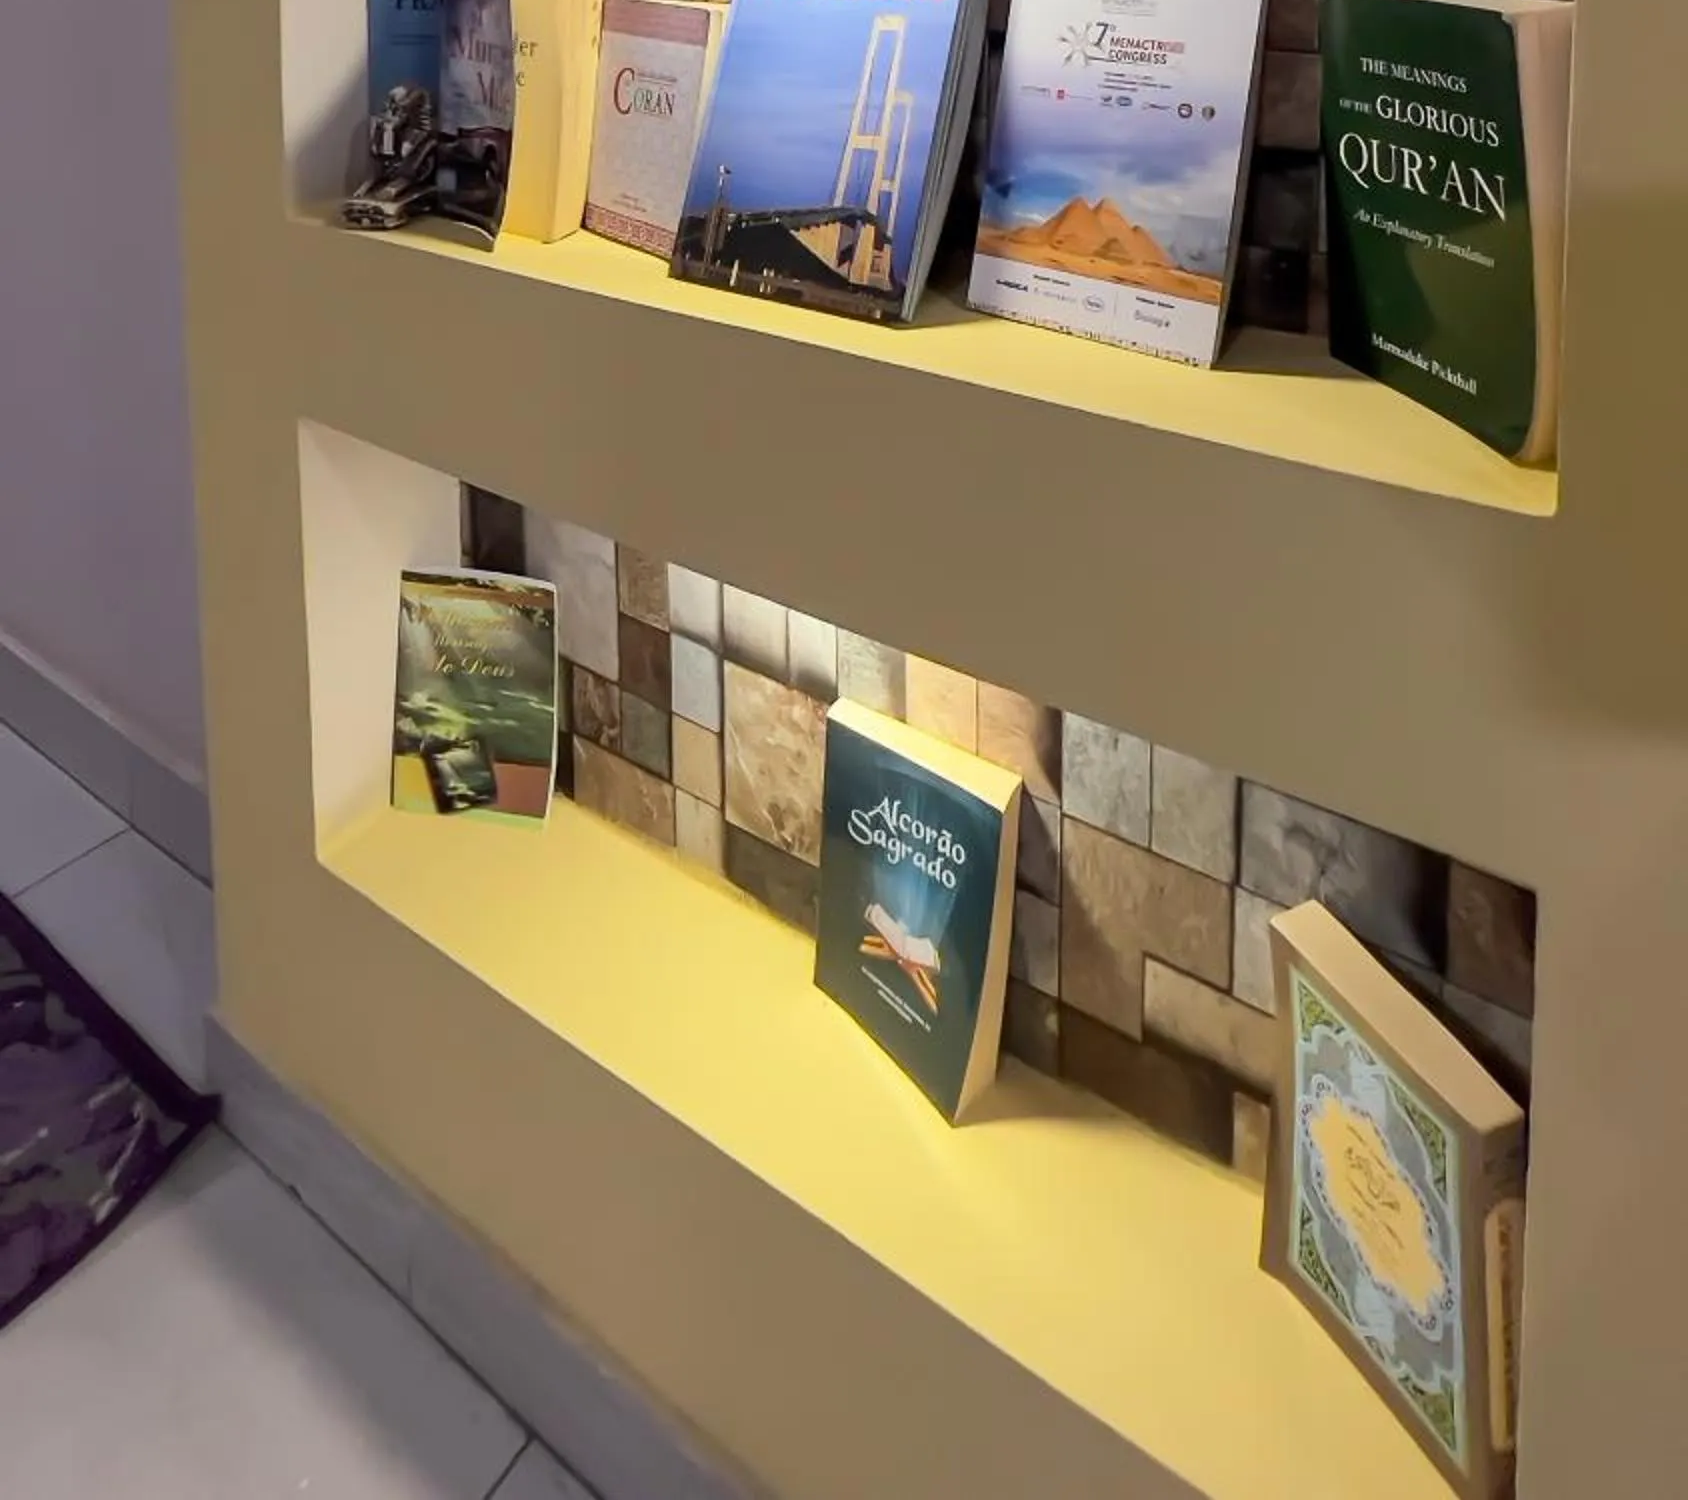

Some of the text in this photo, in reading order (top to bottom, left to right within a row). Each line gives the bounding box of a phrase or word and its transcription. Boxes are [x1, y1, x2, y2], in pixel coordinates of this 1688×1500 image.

[1360, 57, 1468, 93] THE MEANINGS
[1375, 94, 1500, 148] GLORIOUS
[1338, 131, 1507, 223] QUR'AN
[847, 809, 957, 889] Sagrado
[867, 796, 965, 865] Alcorão
